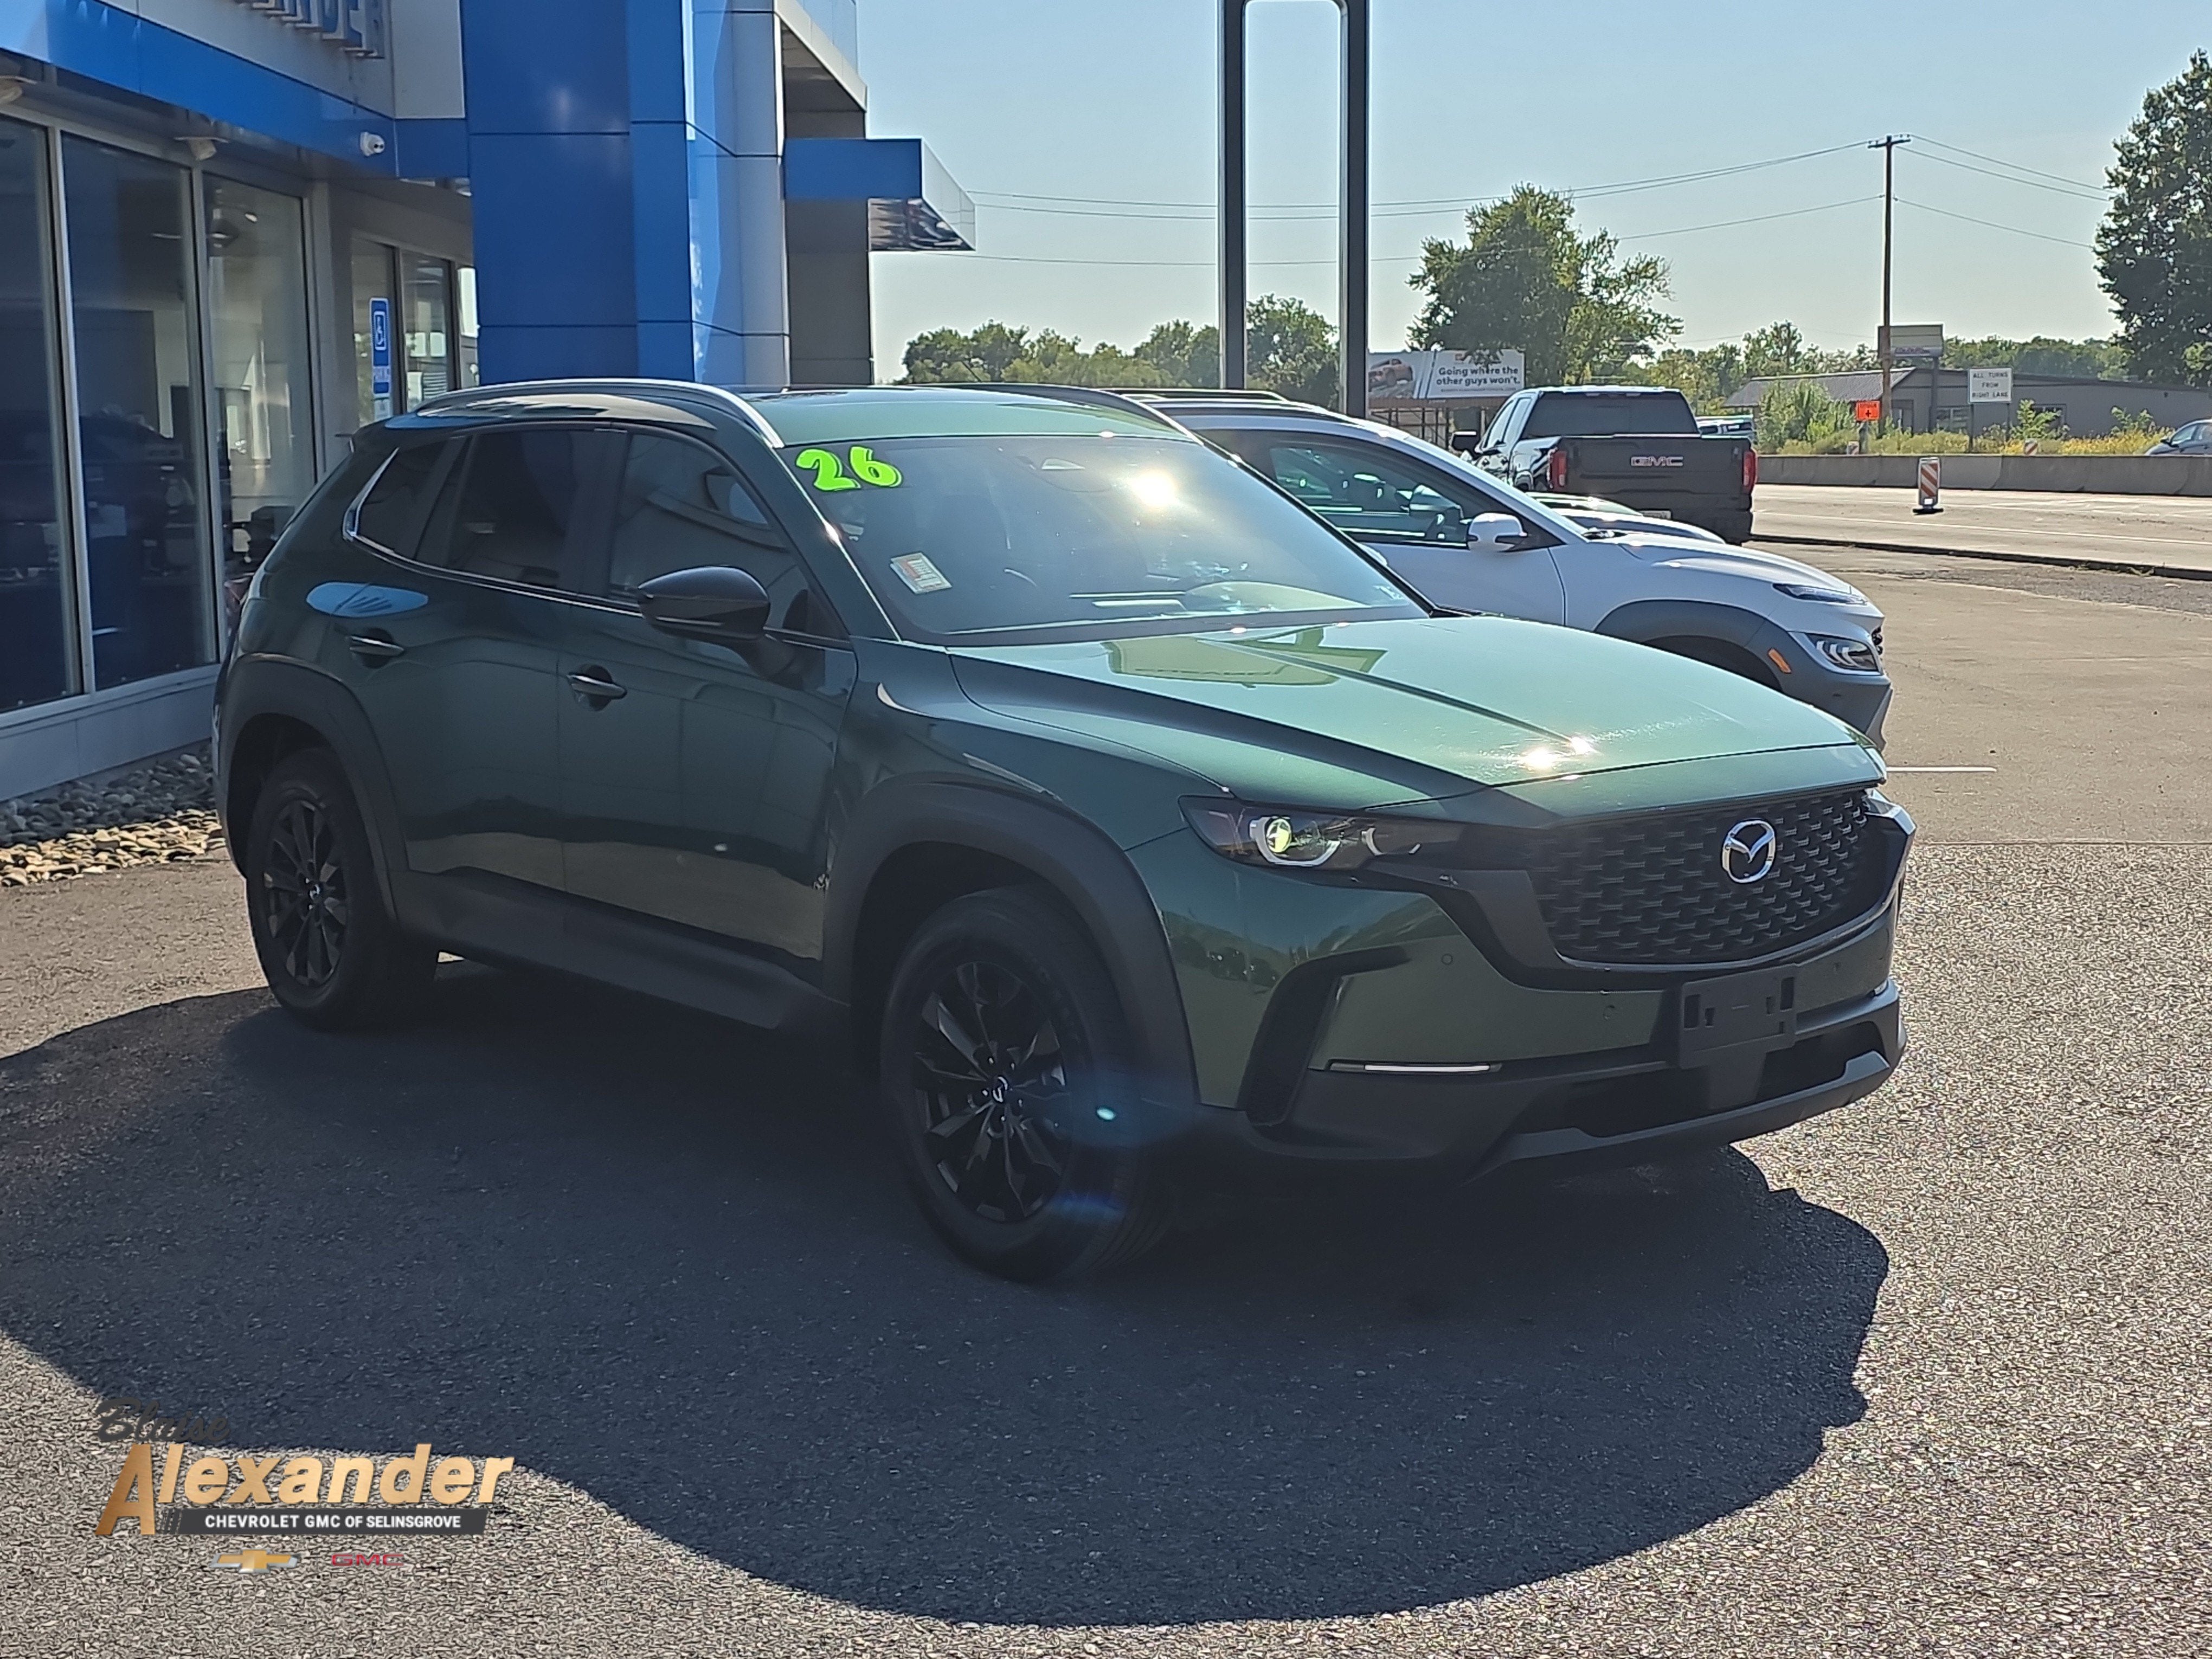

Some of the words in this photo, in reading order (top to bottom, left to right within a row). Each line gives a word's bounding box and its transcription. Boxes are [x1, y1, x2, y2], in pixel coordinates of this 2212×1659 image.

[1438, 366, 1468, 377] Going
[1502, 366, 1519, 374] the
[1436, 376, 1464, 385] other
[1464, 378, 1488, 387] guys
[1489, 376, 1521, 384] won't.
[1630, 456, 1684, 467] GMC
[795, 445, 903, 491] 26
